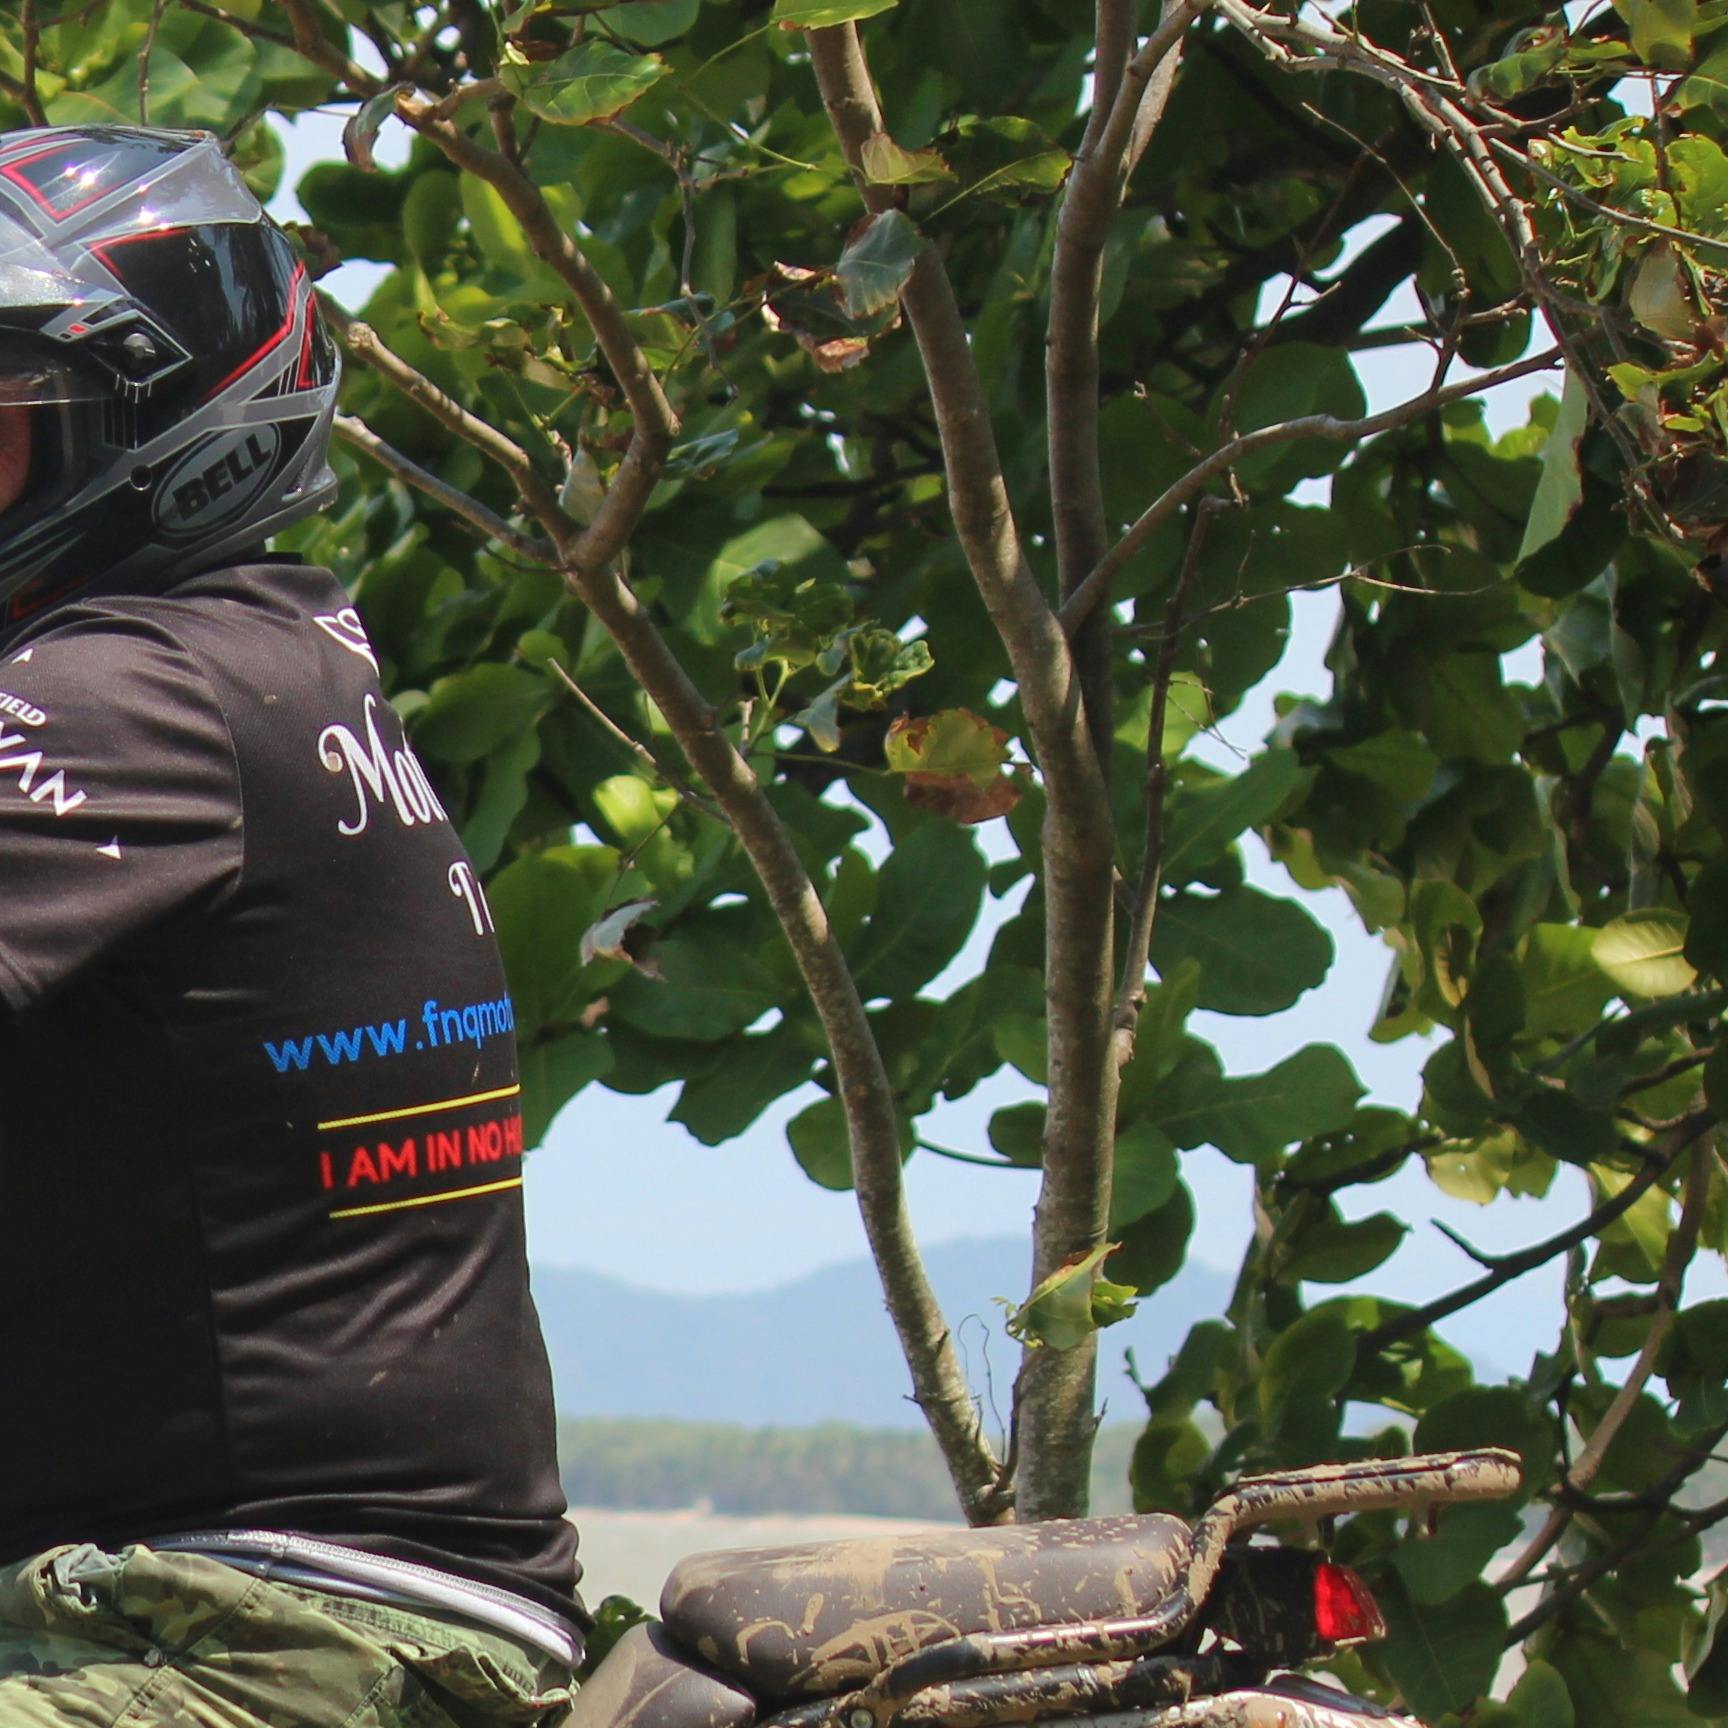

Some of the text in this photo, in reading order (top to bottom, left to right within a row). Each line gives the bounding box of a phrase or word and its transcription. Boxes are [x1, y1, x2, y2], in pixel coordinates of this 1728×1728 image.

[172, 432, 272, 521] BELL
[320, 1151, 334, 1189] I
[347, 1138, 417, 1187] AM
[426, 1130, 461, 1173] IN
[467, 1121, 502, 1164] NO
